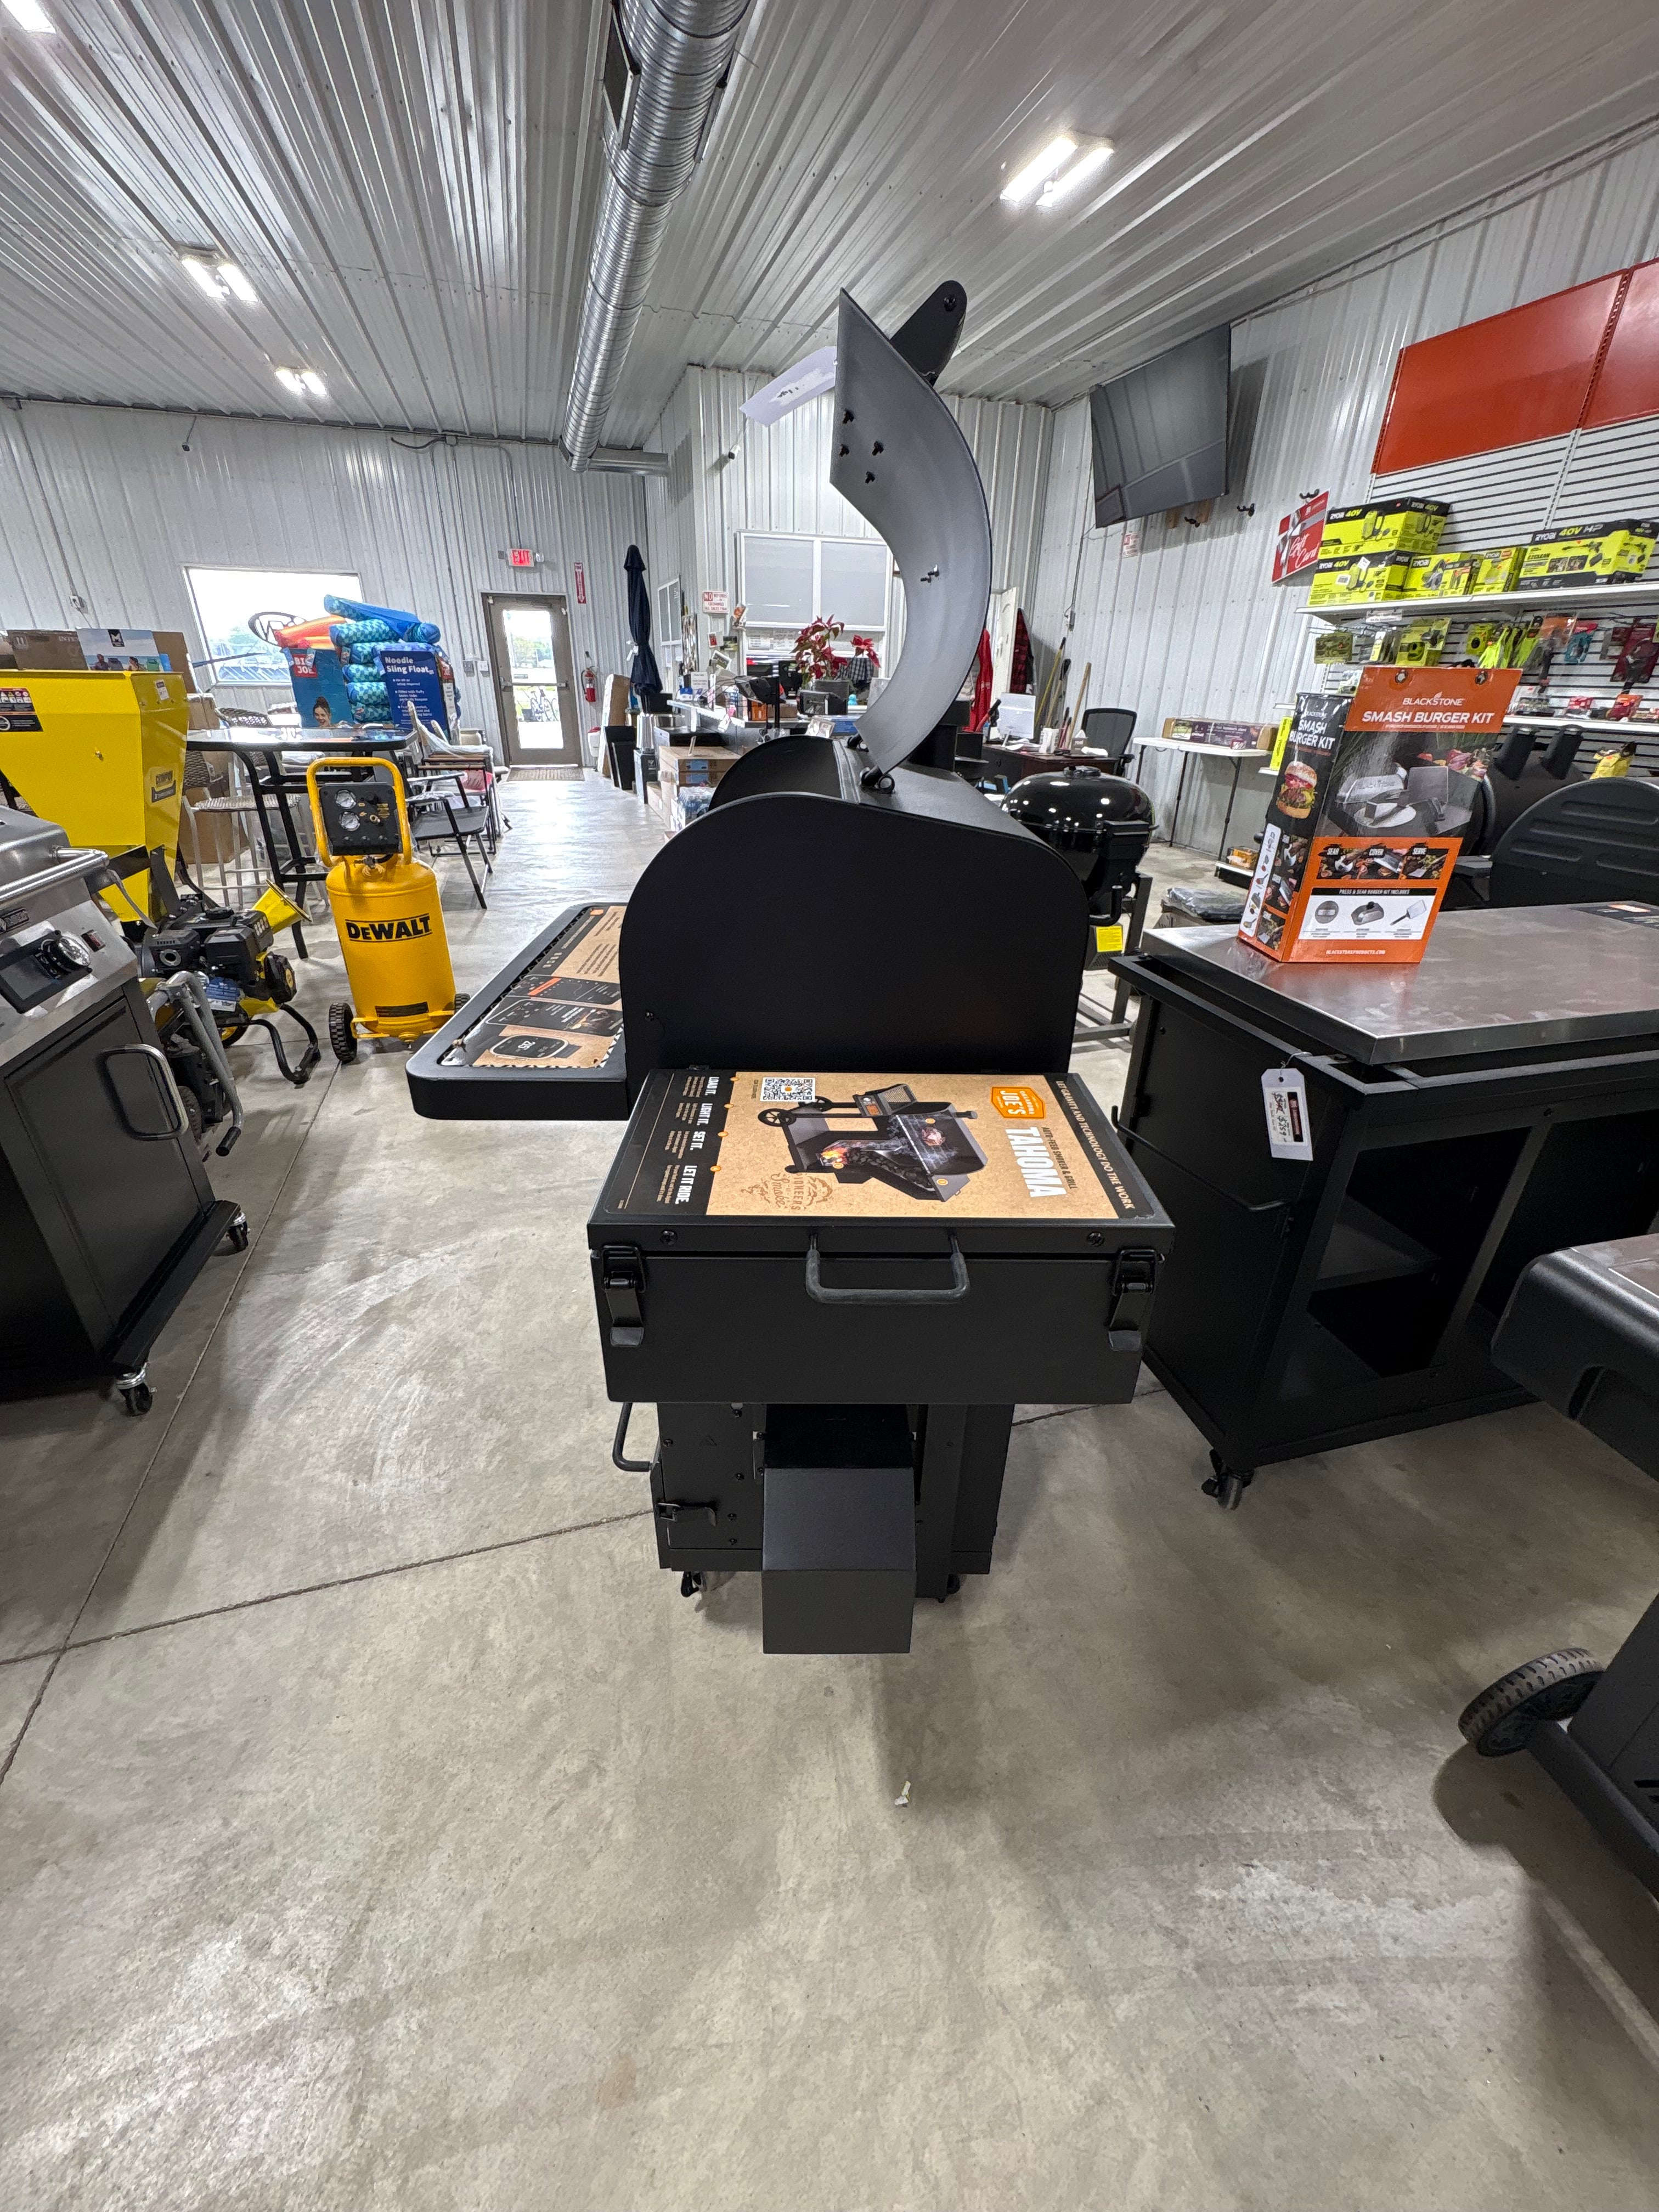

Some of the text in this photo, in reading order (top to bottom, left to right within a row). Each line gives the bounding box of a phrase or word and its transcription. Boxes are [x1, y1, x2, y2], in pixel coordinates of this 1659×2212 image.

[1346, 509, 1363, 517] 40V
[1534, 524, 1604, 541] RYOBI 40V HP
[1290, 533, 1310, 558] Gift
[512, 550, 530, 564] EXIT
[1295, 543, 1320, 568] Card
[294, 657, 311, 665] BI
[385, 656, 414, 664] Noodle
[386, 665, 429, 674] Sling Float
[1402, 697, 1463, 706] BLACKSTONE
[1362, 711, 1495, 724] SMASH BURGER KIT
[1298, 719, 1328, 735] SMASH
[1289, 730, 1336, 750] BURGER KIT
[345, 916, 430, 940] DEWALT
[707, 1076, 720, 1089] LOAD
[699, 1103, 713, 1118] LIGHT
[1000, 1090, 1026, 1115] JOE'S
[690, 1131, 706, 1150] SET IT.
[1056, 1080, 1136, 1210] LET GRAVITY AND TECHNOLOGY DO THE WORK
[1005, 1126, 1067, 1198] TAHOMA
[1042, 1126, 1059, 1151] AUTO-FEED
[1052, 1149, 1068, 1170] SMOKER
[1064, 1176, 1078, 1190] GRILL
[683, 1165, 697, 1177] LET
[675, 1185, 692, 1205] RIDE.
[770, 1172, 791, 1208] Smoke
